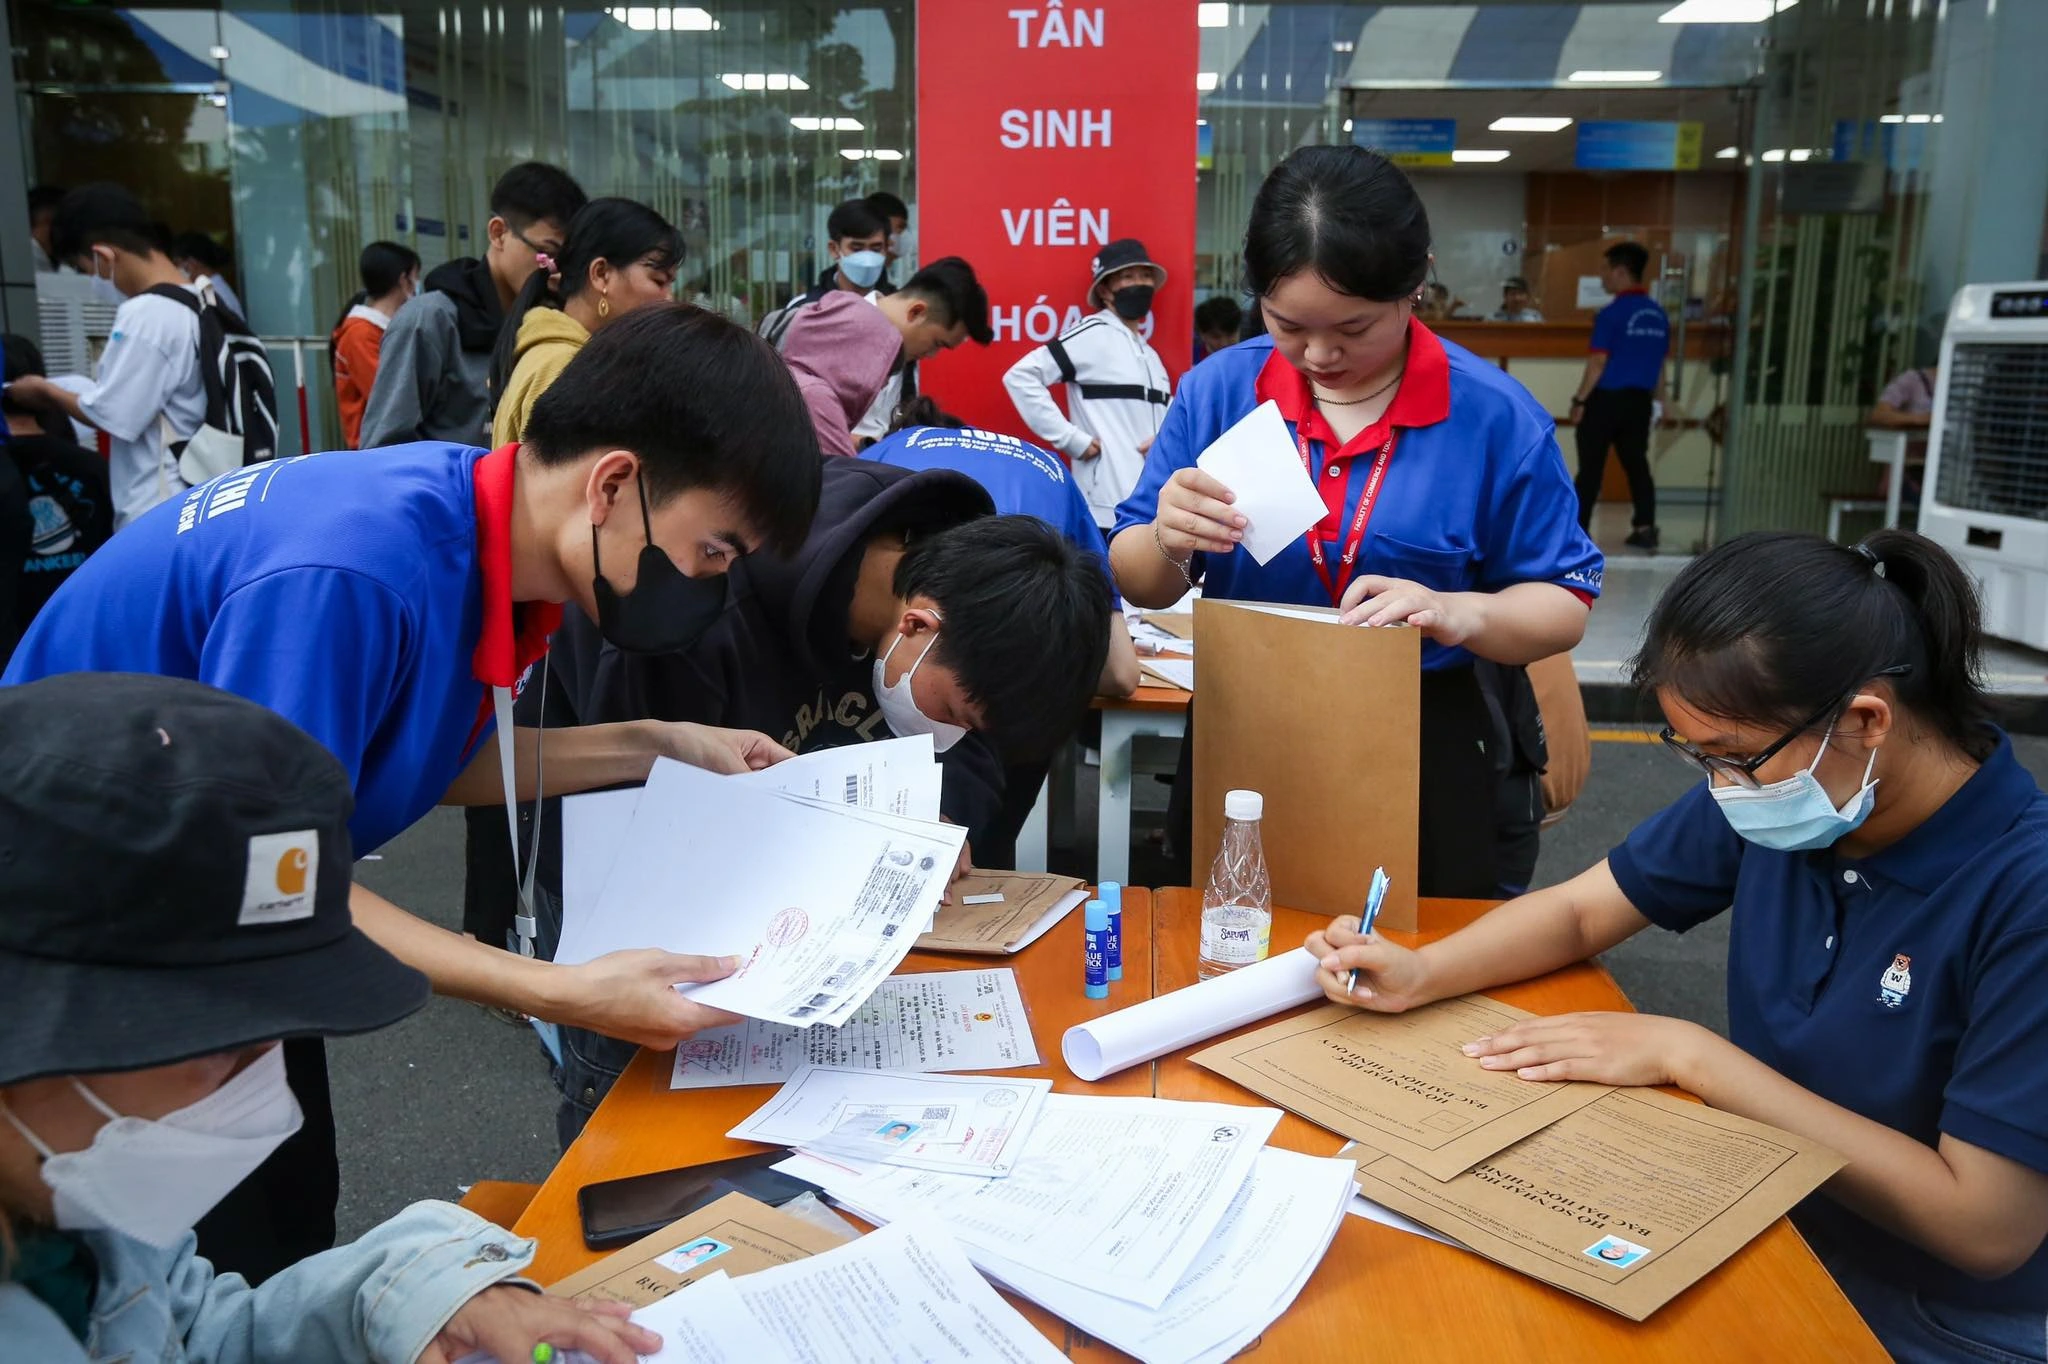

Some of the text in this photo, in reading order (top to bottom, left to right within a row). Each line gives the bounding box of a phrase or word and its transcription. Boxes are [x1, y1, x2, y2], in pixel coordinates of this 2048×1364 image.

[1008, 0, 1104, 48] TÂN
[1000, 109, 1112, 149] SINH
[1001, 198, 1109, 246] VIÊN
[1354, 505, 1368, 531] FACULTY
